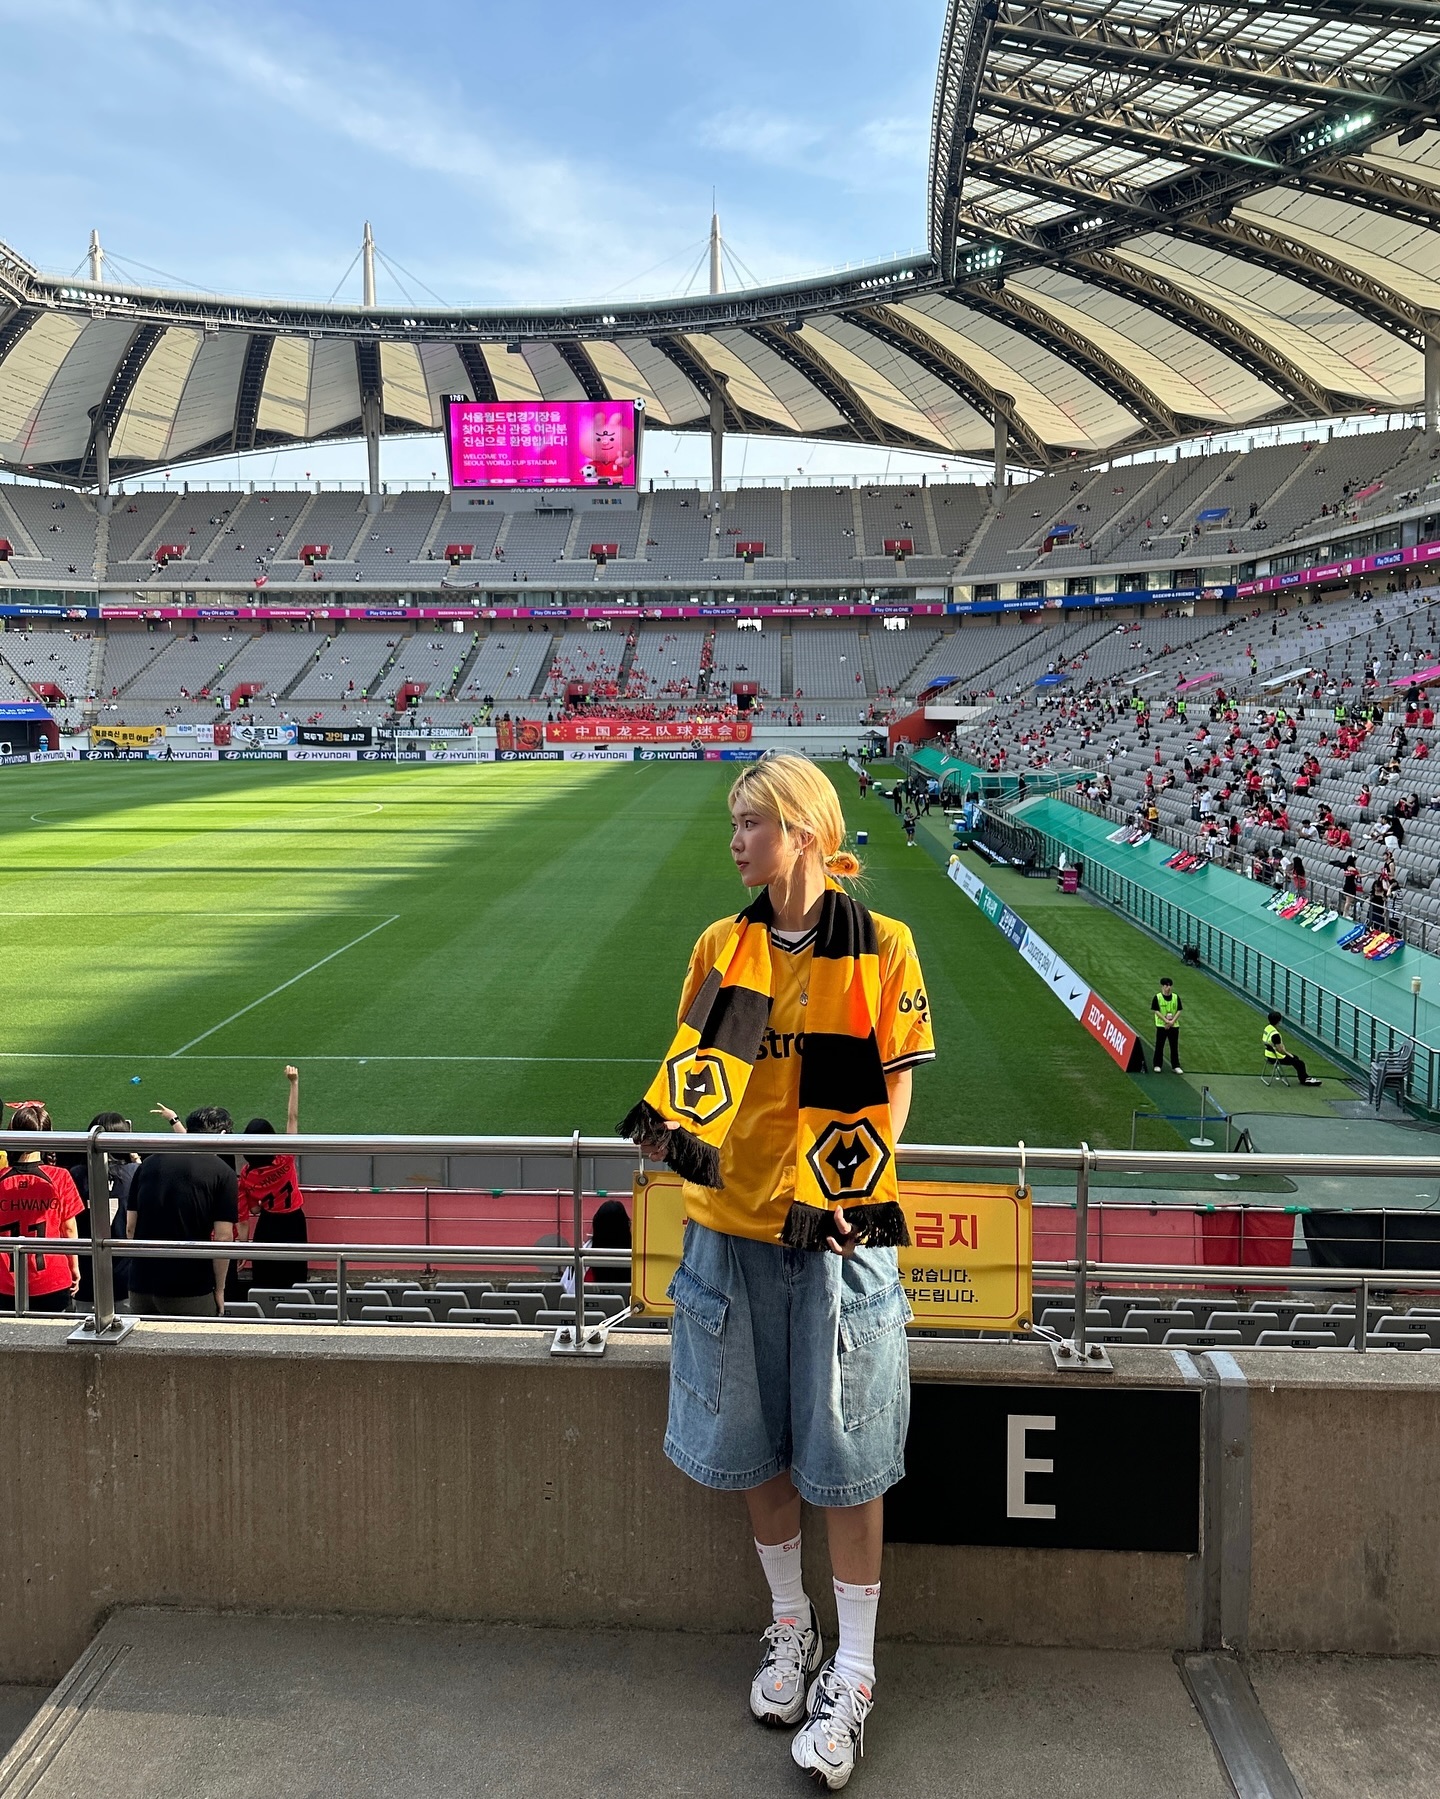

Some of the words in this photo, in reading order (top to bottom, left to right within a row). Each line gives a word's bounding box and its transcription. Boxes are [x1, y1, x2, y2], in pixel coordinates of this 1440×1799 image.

[462, 412, 560, 423] 서울월드컵경기장을
[462, 424, 506, 435] 찾아주신
[510, 424, 531, 435] 관중
[534, 424, 567, 434] 여러분
[463, 436, 507, 447] 진심으로
[510, 436, 567, 446] 환영합니다!
[240, 728, 278, 740] 손흥민
[378, 729, 392, 738] THE
[393, 729, 419, 737] LEGEND
[575, 725, 733, 736] 中国龙之队球迷会
[303, 732, 324, 741] 모두가
[351, 733, 365, 741] 시간
[4, 755, 28, 764] HYUNDAI
[1088, 1004, 1105, 1030] HDC
[1103, 1020, 1127, 1056] IPARK
[10, 1198, 59, 1211] HWANG
[914, 1211, 979, 1250] 금지
[912, 1268, 972, 1283] 없습니다.
[905, 1289, 978, 1303] 탁드립니다.
[1007, 1414, 1056, 1519] E
